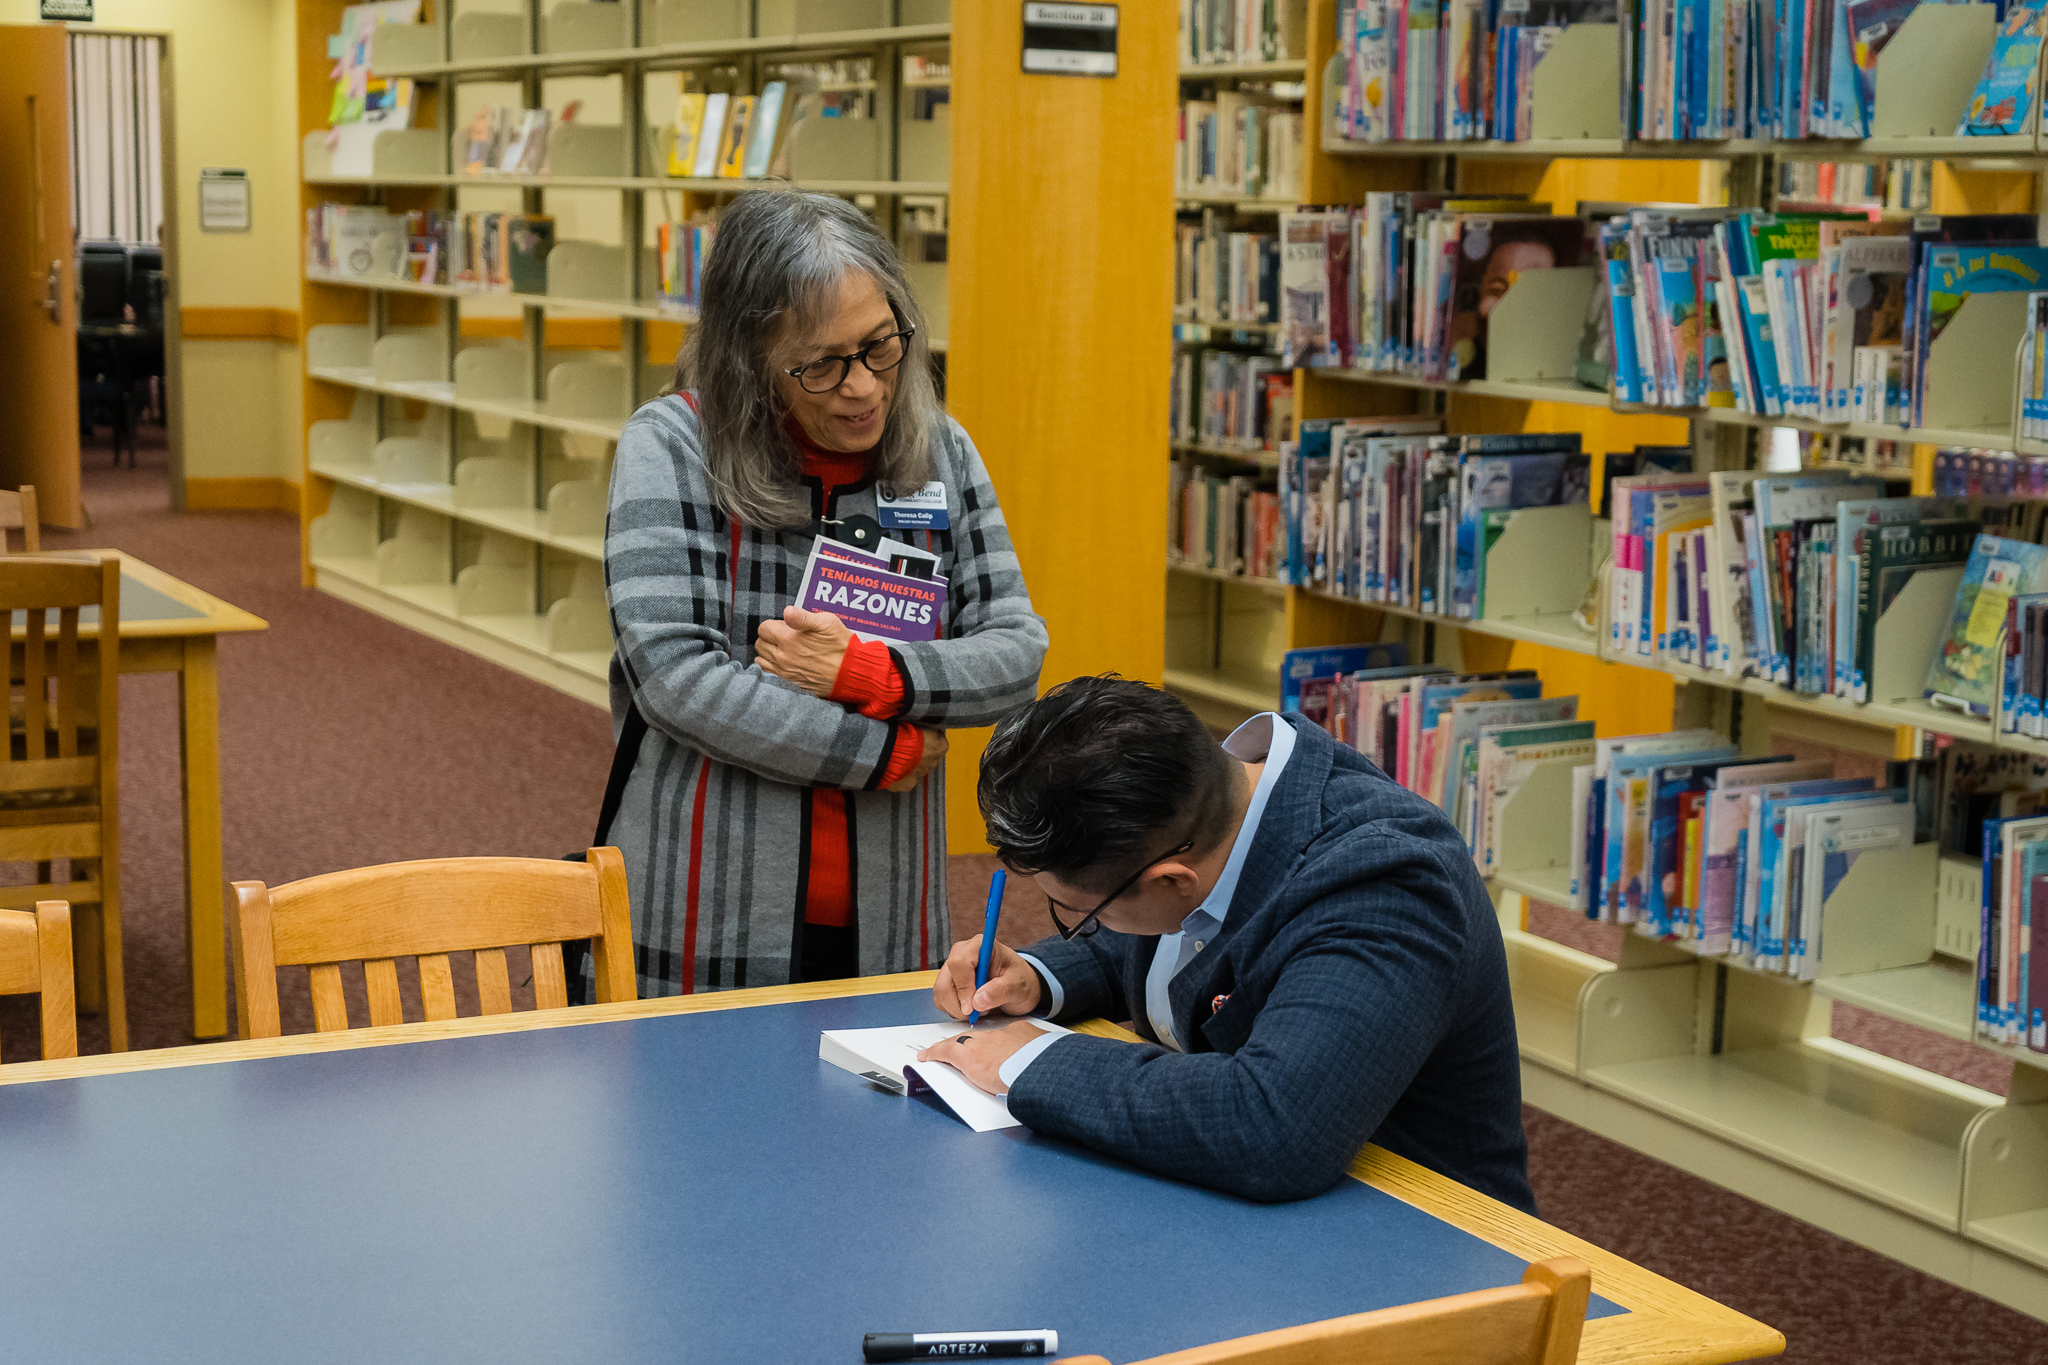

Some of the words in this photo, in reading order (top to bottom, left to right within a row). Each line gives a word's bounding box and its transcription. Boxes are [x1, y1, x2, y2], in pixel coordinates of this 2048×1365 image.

[918, 488, 942, 498] Bend
[893, 511, 917, 519] Theresa
[821, 567, 879, 590] TENÍAMOS
[881, 581, 936, 602] NUESTRAS
[814, 580, 933, 625] RAZONES
[929, 1343, 987, 1354] ARTEZA
